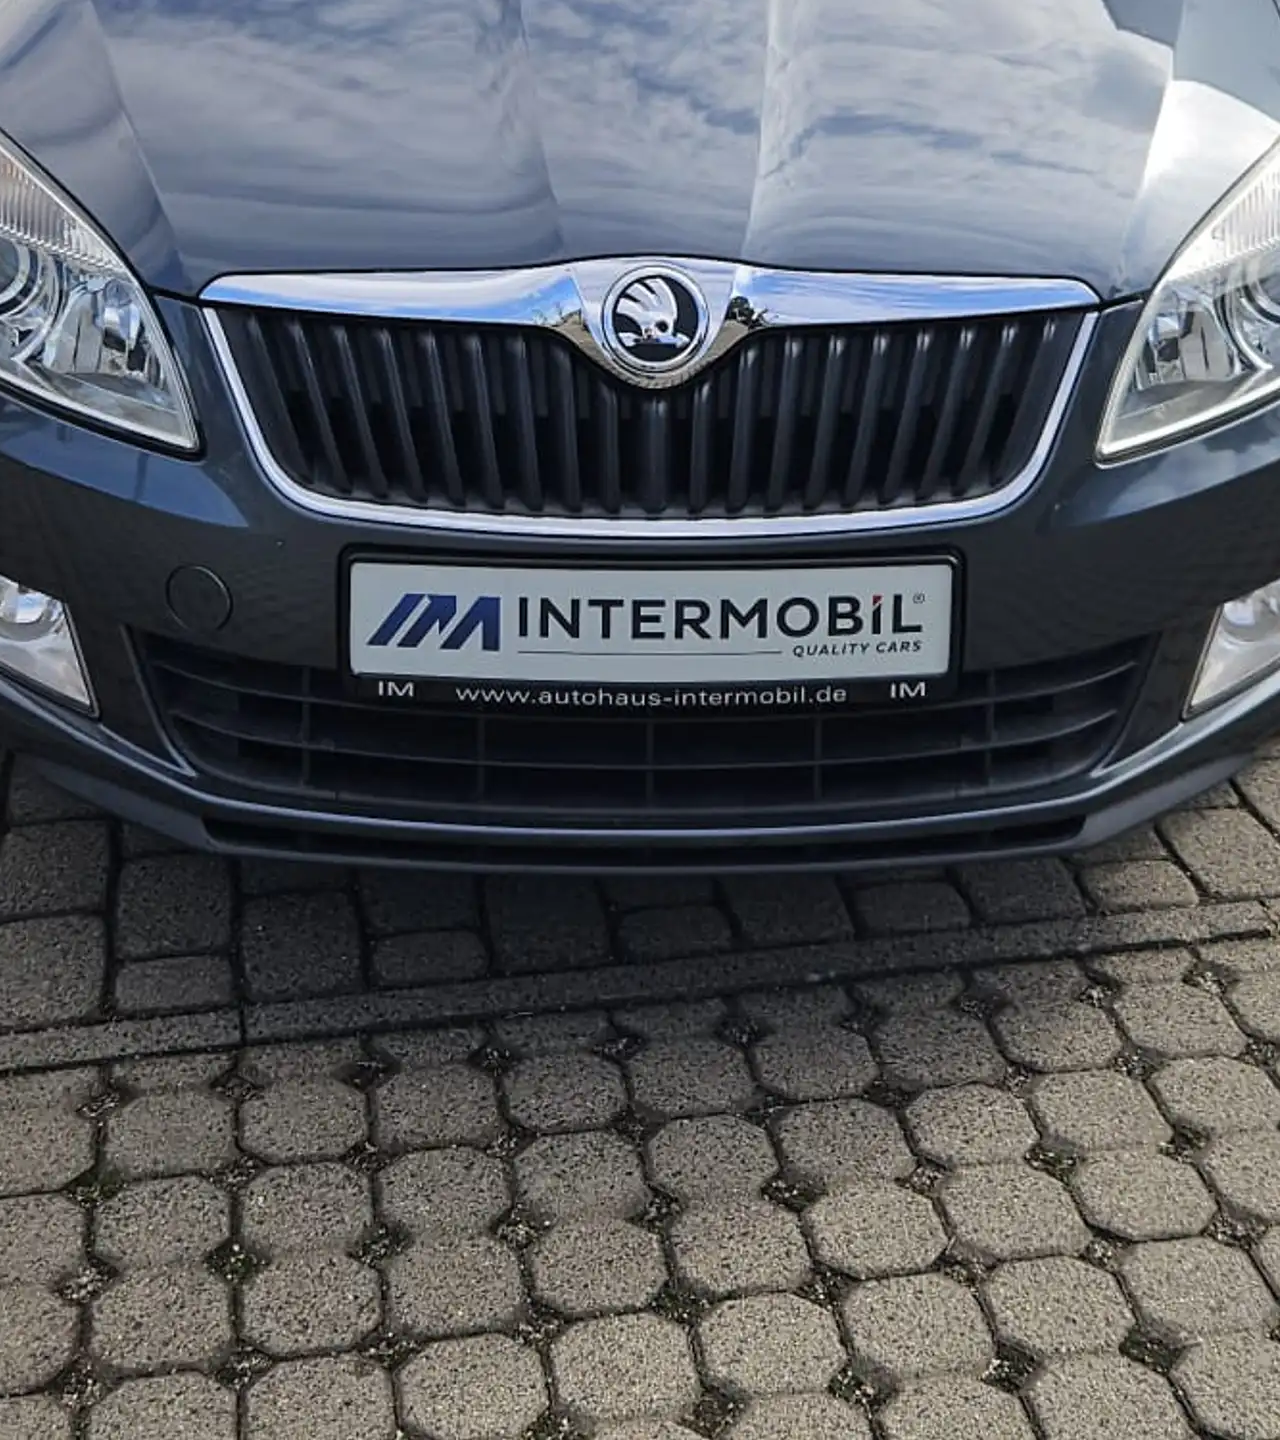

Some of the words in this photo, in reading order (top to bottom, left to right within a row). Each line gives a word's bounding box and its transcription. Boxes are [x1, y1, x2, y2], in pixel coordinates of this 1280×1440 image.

[792, 641, 869, 658] QUALITY
[876, 639, 922, 654] CARS
[377, 680, 415, 697] IM
[455, 685, 847, 707] www.autohaus-intermobil.de
[890, 681, 926, 699] IM
